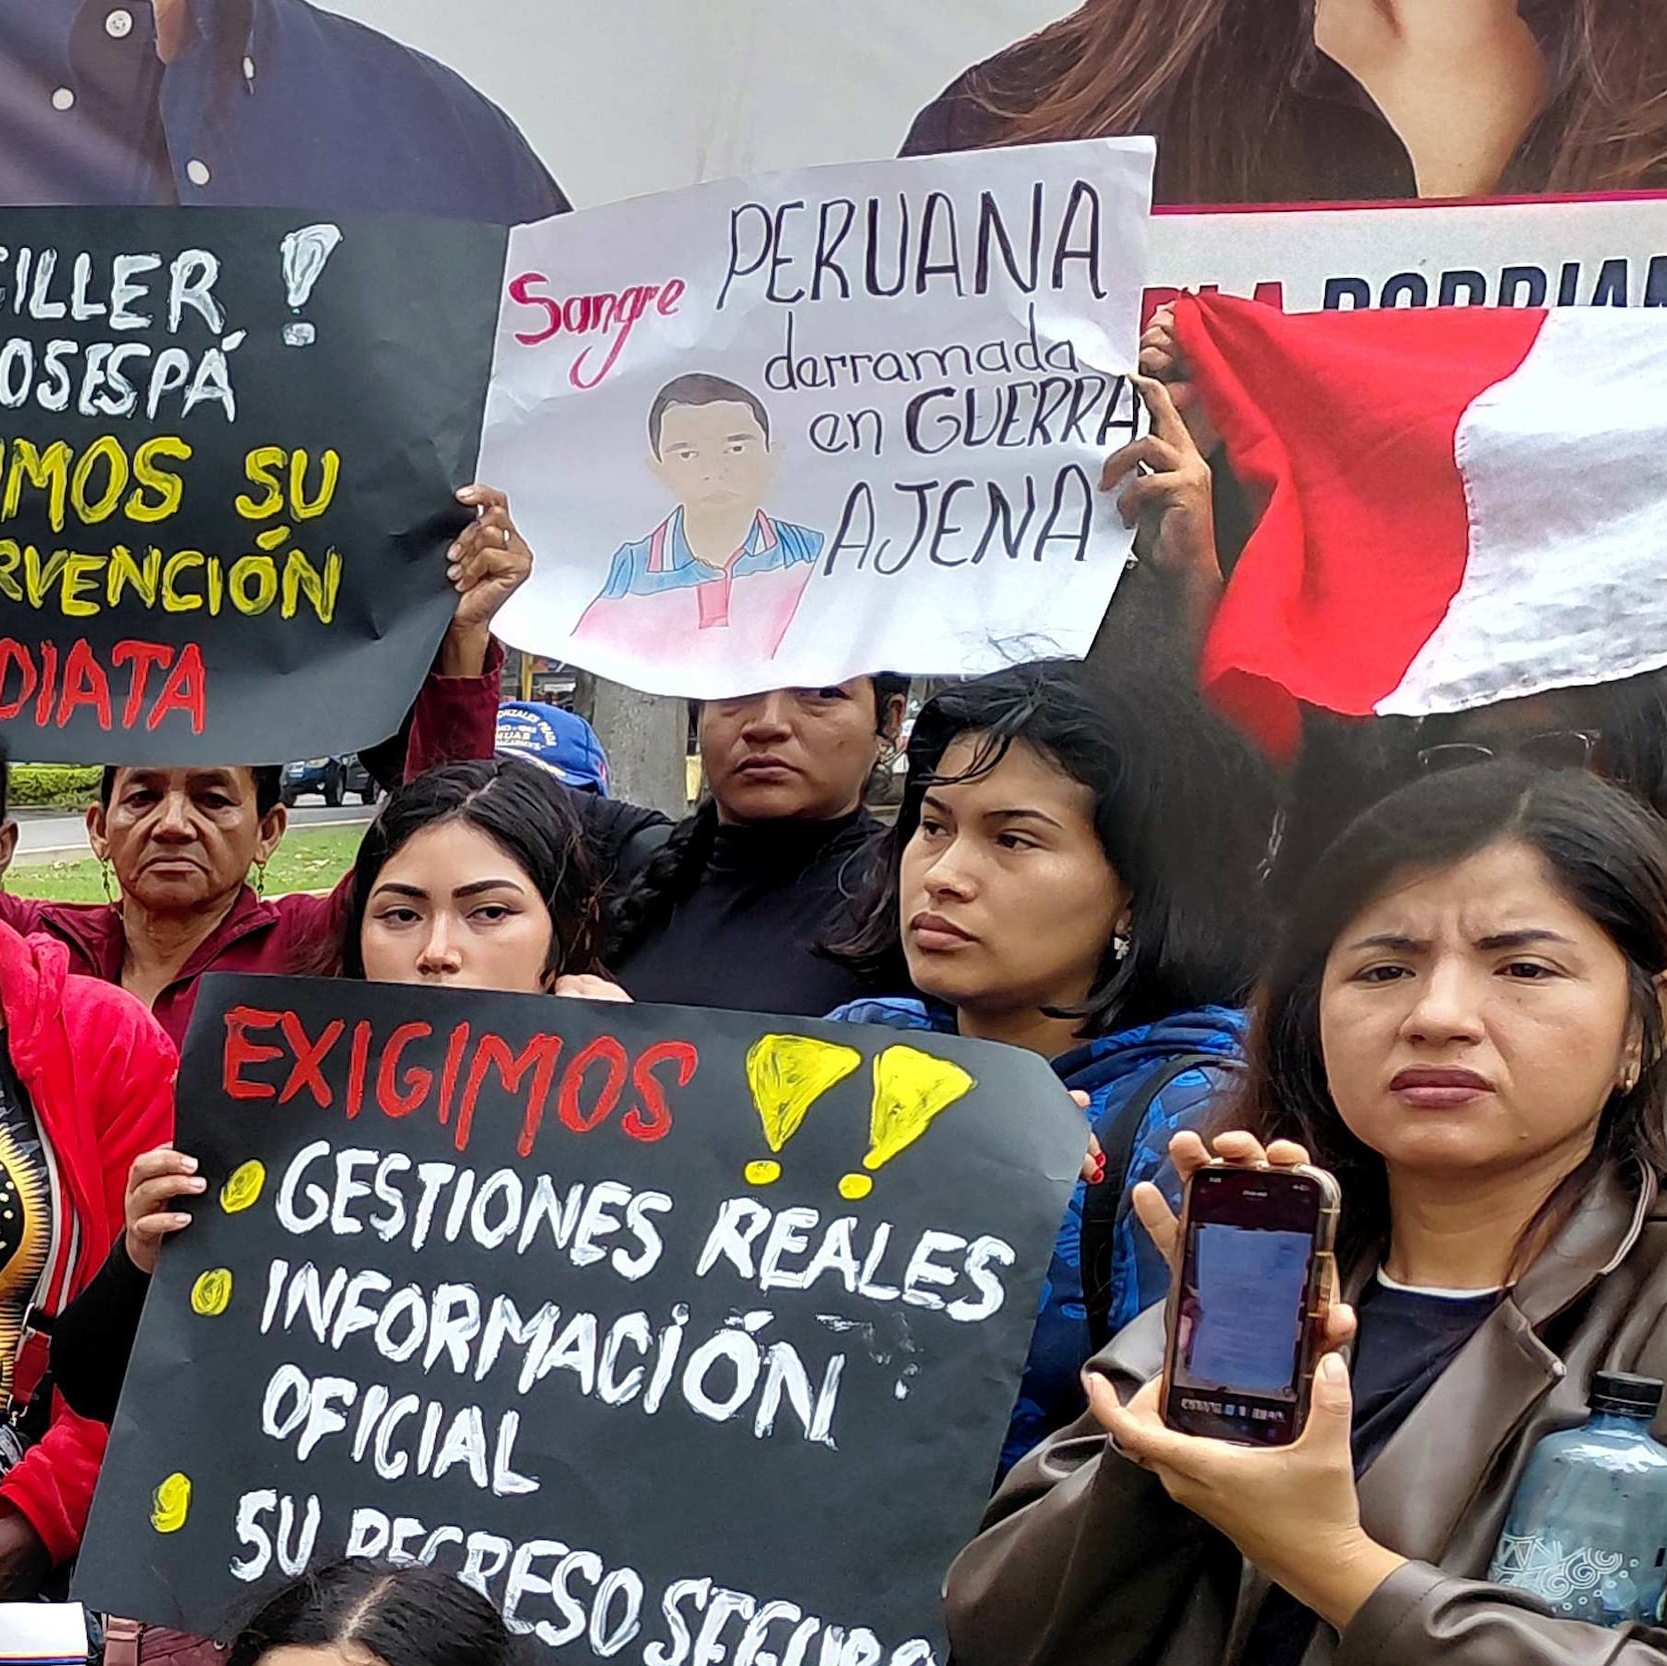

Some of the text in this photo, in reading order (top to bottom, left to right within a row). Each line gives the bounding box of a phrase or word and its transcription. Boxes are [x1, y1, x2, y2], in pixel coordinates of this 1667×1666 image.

[717, 180, 1108, 309] PERUANA
[508, 272, 686, 389] Sangre
[765, 303, 1079, 393] derramada
[810, 375, 1140, 455] en GUERRA
[236, 445, 341, 521] SU
[824, 464, 1093, 576] AJENA
[222, 1005, 699, 1157] EXIGIMOS
[276, 1139, 1015, 1323] GESTIONES REALES
[259, 1258, 845, 1452] INFORMACIÓN
[263, 1363, 539, 1498] OFICIAL
[229, 1487, 322, 1582] SU
